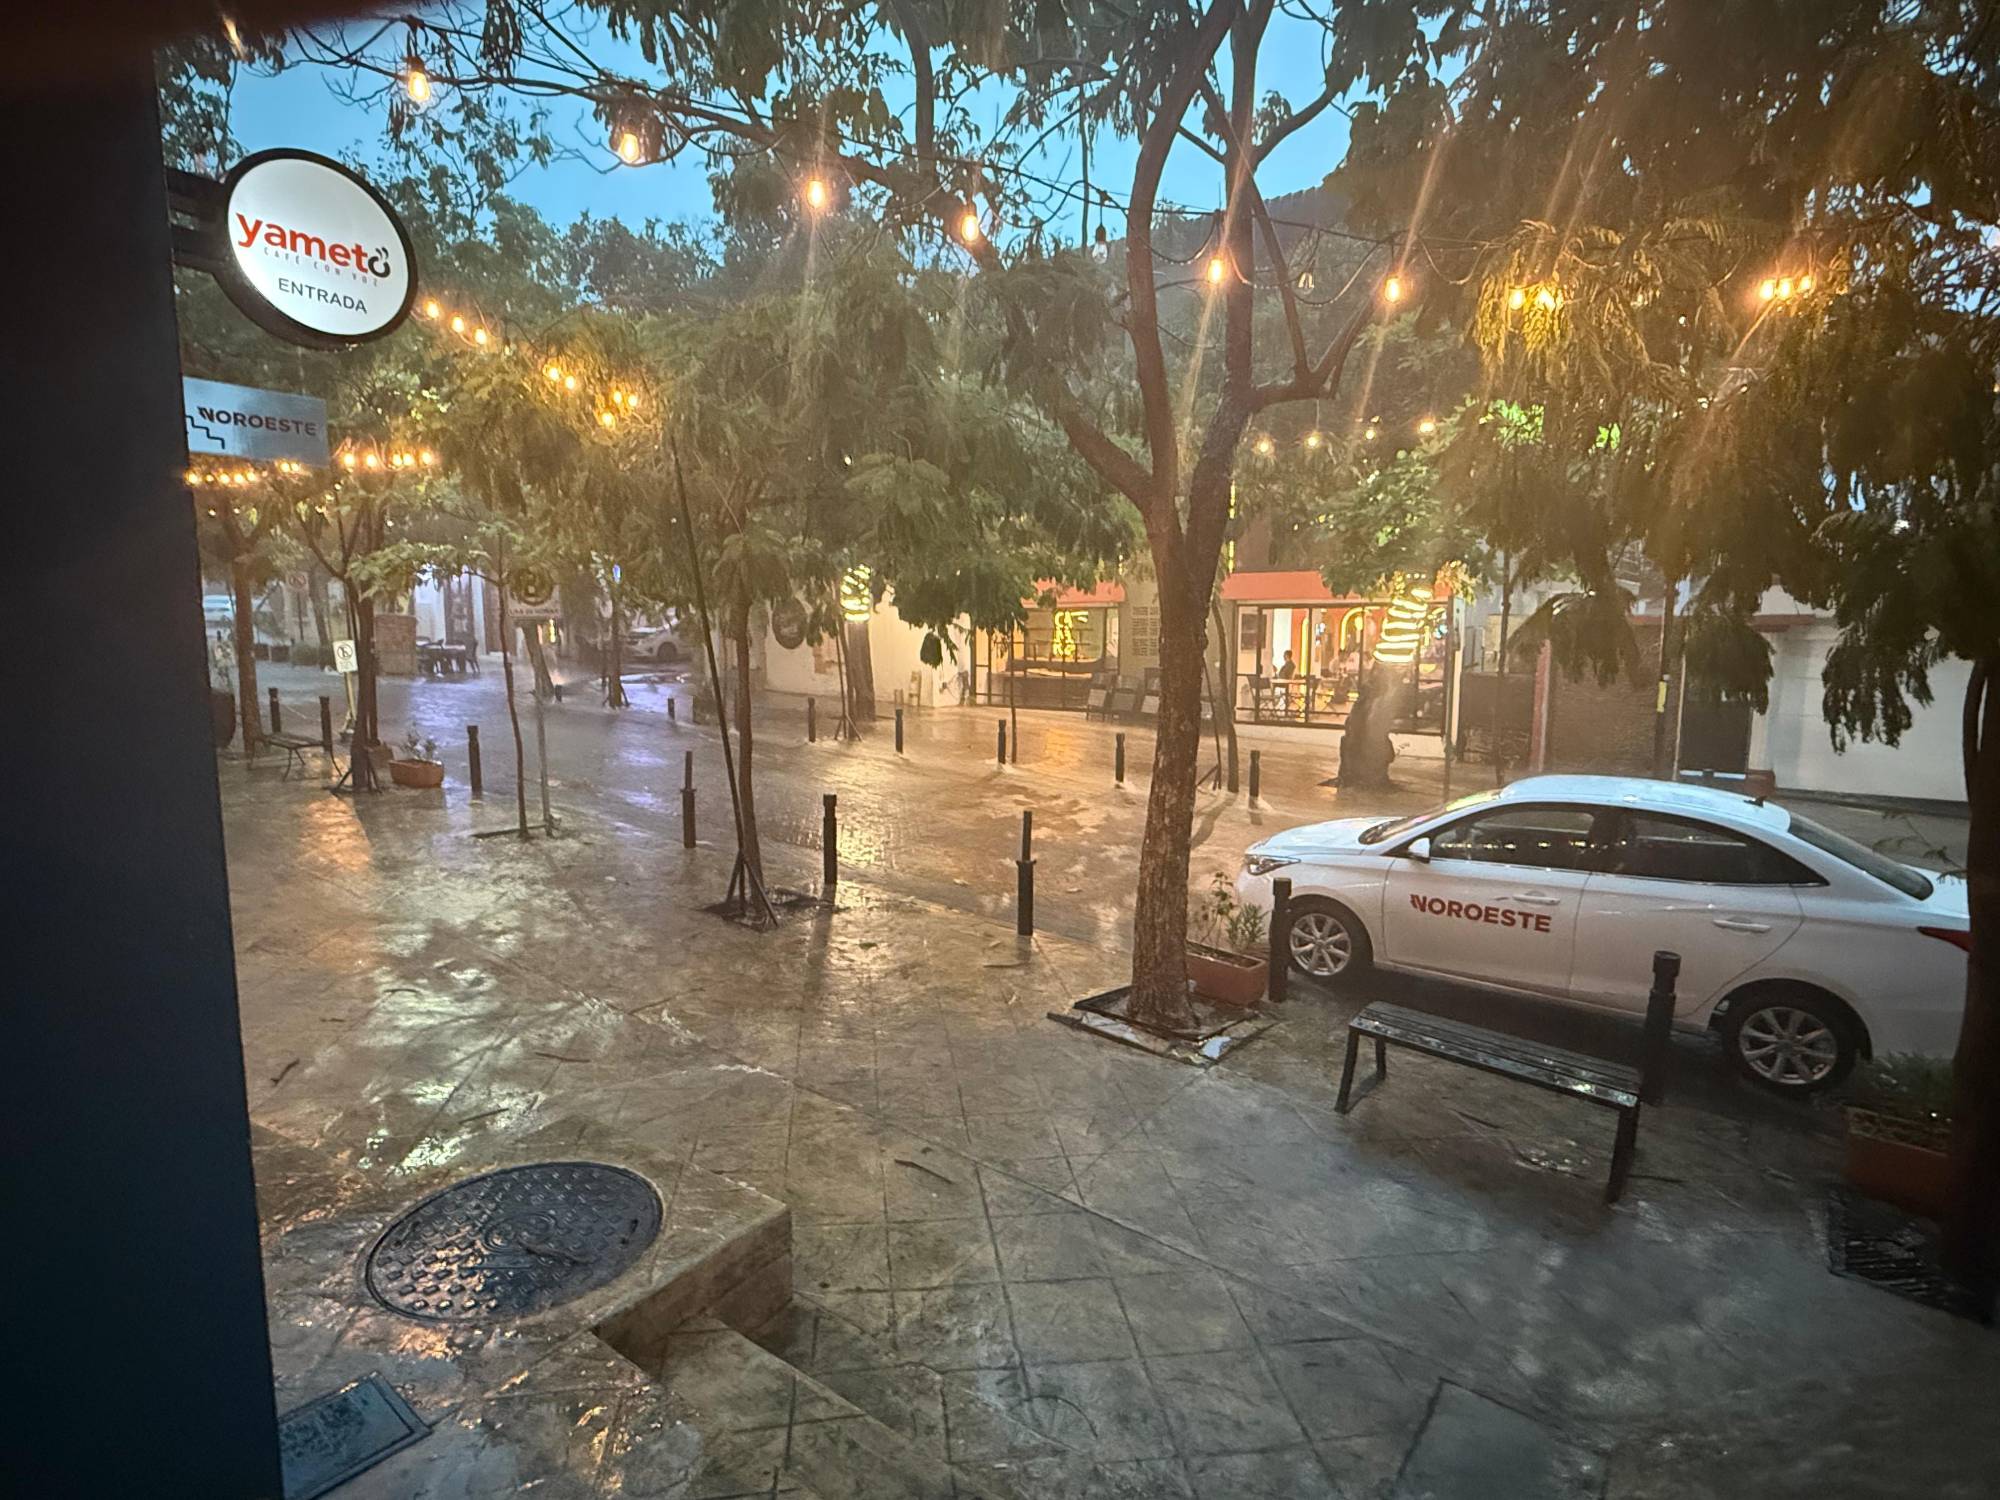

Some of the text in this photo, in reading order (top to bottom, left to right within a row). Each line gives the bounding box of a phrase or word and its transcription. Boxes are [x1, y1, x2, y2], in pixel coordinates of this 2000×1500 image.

[278, 277, 368, 315] ENTRADA
[197, 405, 318, 437] NOROESTE
[1410, 893, 1553, 933] NOROESTE
